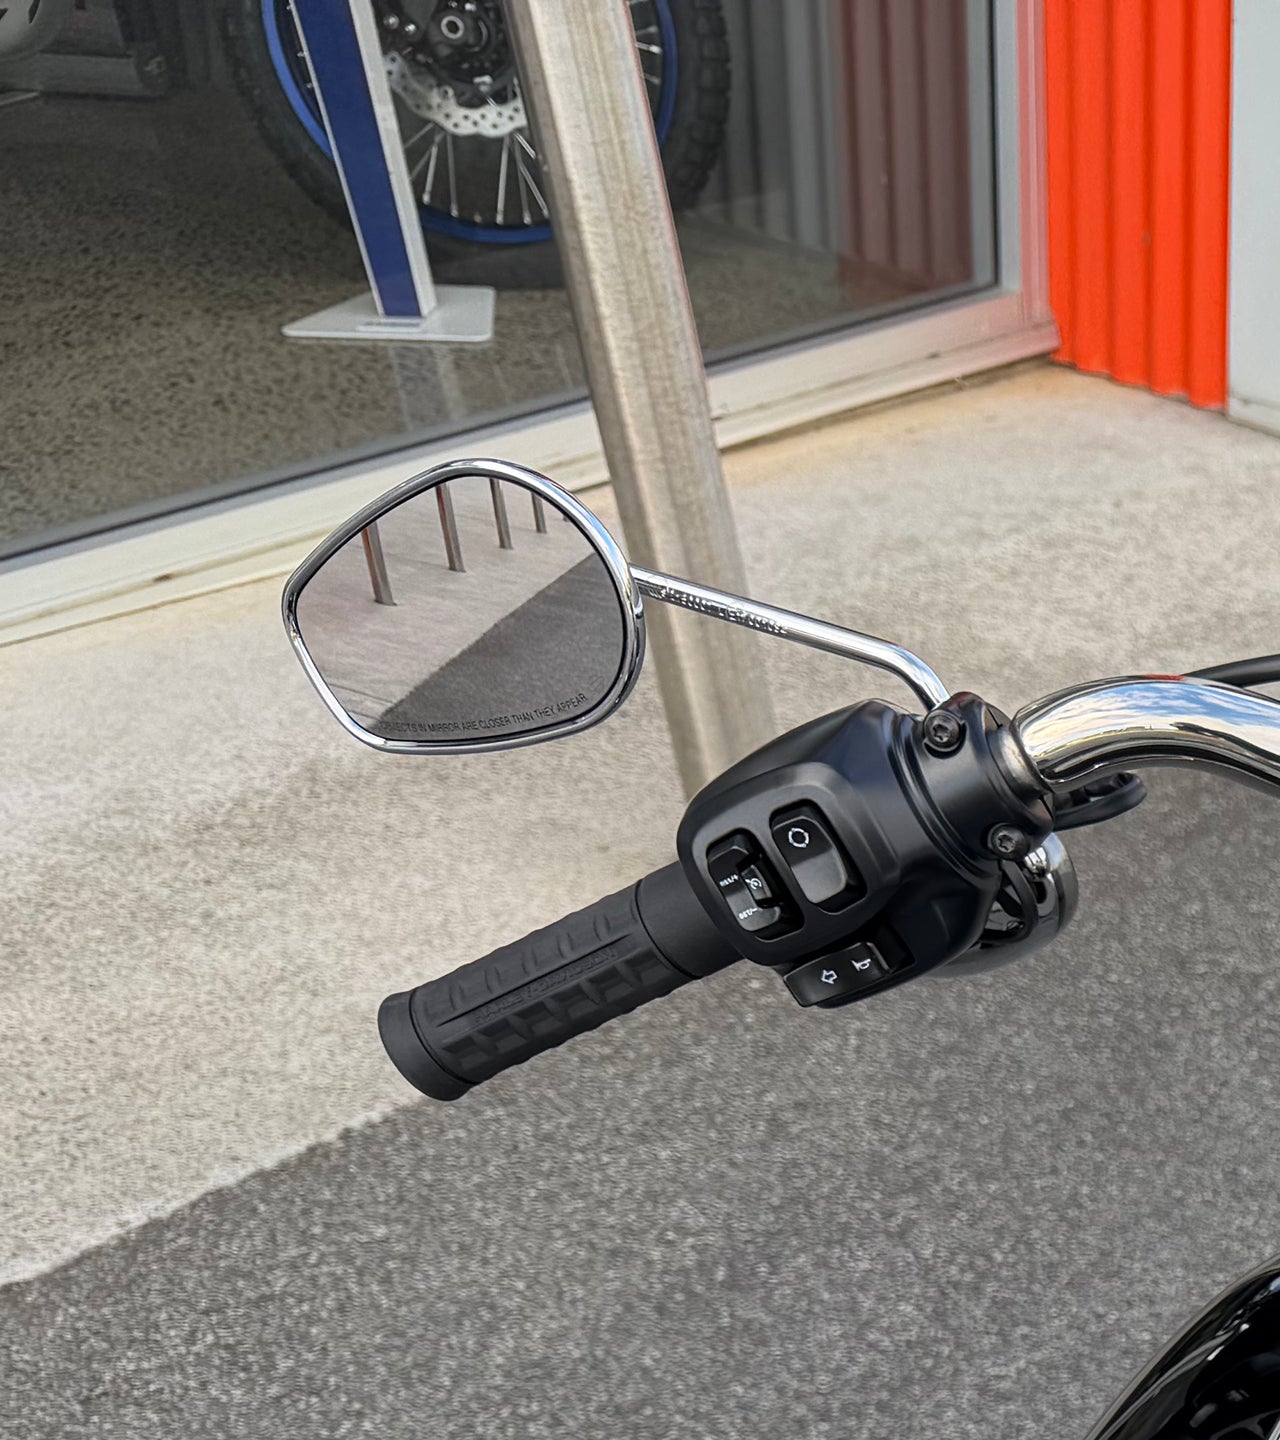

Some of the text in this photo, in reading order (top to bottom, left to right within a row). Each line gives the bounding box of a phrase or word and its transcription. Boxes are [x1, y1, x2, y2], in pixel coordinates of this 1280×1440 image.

[460, 720, 478, 731] ARE
[480, 715, 511, 729] CLOSER
[512, 711, 534, 724] THAN
[534, 705, 556, 719] THEY
[556, 692, 588, 712] APPEAR
